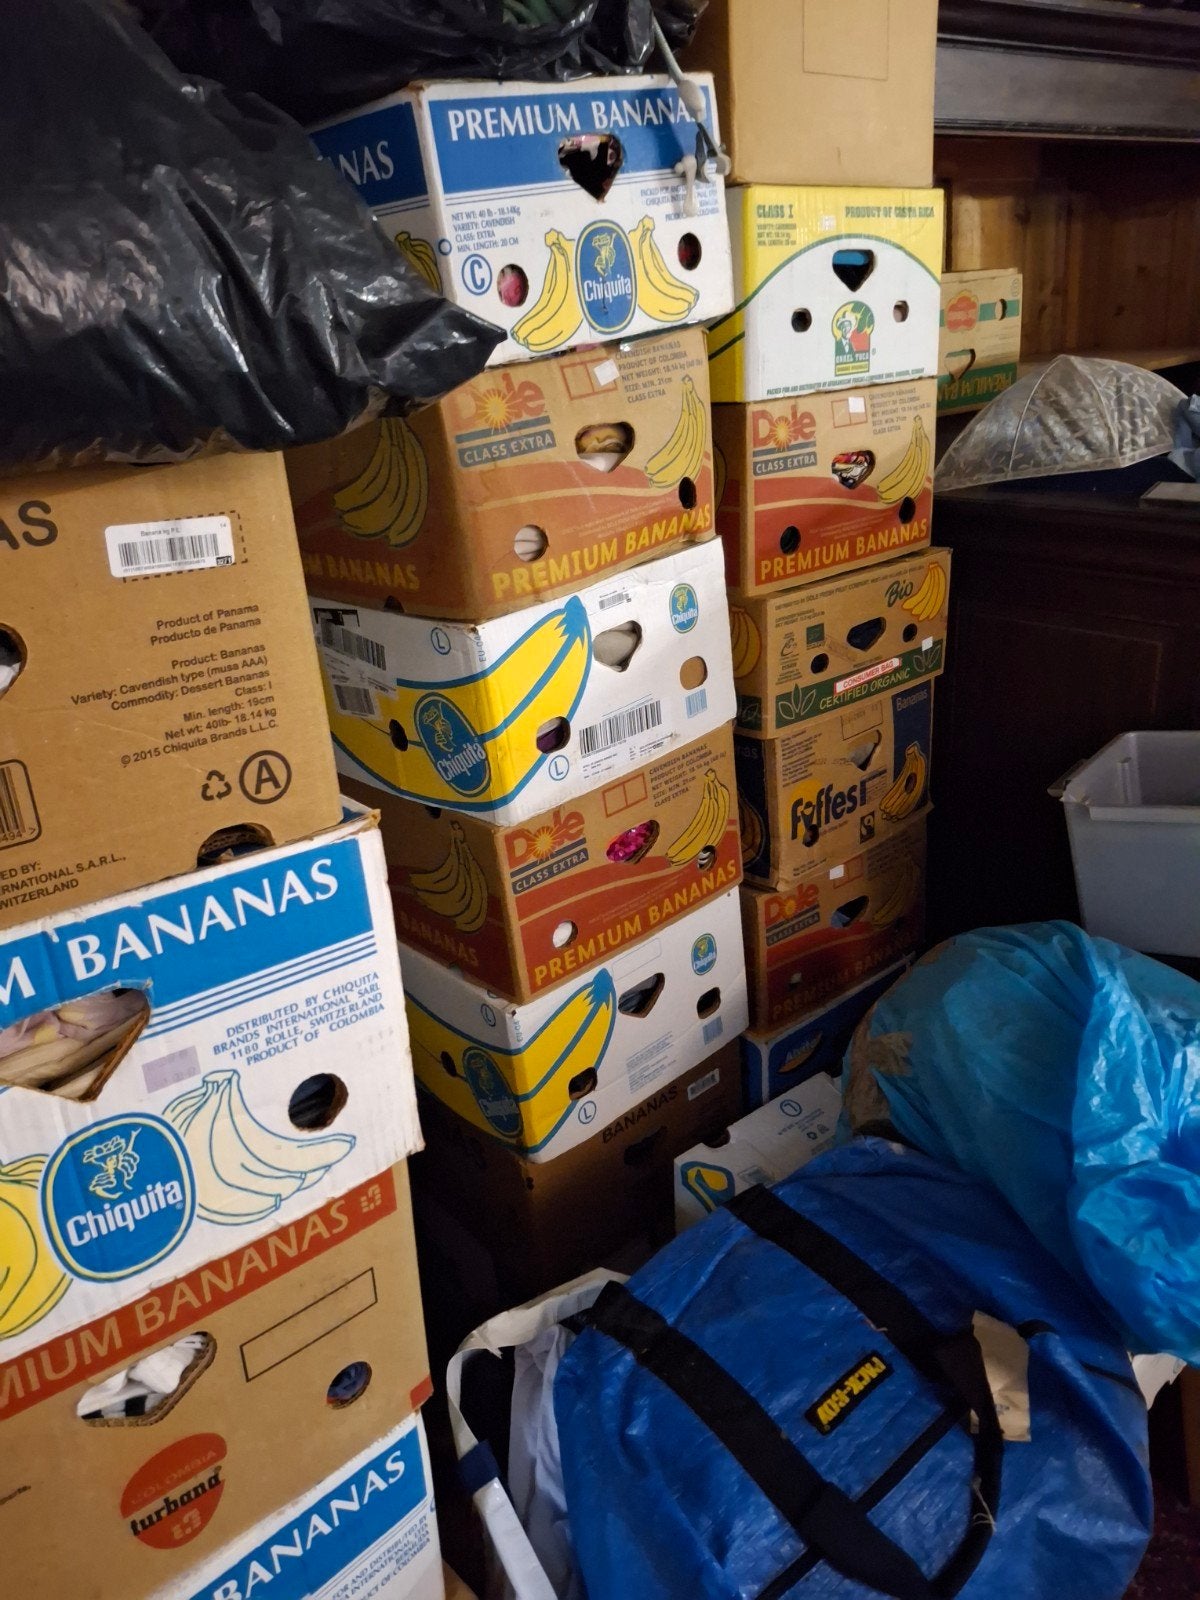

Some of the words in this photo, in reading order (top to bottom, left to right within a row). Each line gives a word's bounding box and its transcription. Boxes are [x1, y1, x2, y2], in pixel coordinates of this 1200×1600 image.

[448, 103, 581, 141] PREMIUM
[592, 96, 698, 130] BANANA
[452, 212, 463, 221] NET
[481, 216, 515, 228] CAVENDISH
[757, 205, 785, 218] CLASS
[788, 205, 794, 218] I
[845, 206, 882, 218] PRODUCT
[883, 206, 892, 218] OF
[894, 206, 917, 218] COSTA
[477, 230, 495, 241] EXTRA
[500, 239, 508, 247] 20
[583, 274, 632, 305] Chiquita
[619, 359, 647, 371] PRODUCT
[622, 373, 634, 381] NET
[446, 373, 548, 429] Dole
[628, 393, 647, 403] CLASS
[648, 389, 666, 399] EXTRA
[752, 404, 816, 449] Dole
[463, 443, 507, 464] CLASS
[511, 434, 554, 455] EXTRA
[756, 459, 784, 474] CLASS
[788, 454, 816, 468] EXTRA
[491, 538, 618, 599] PREMIUM
[625, 504, 711, 554] BANANAS
[761, 540, 849, 580] PREMIUM
[856, 519, 927, 555] BANANAS
[885, 580, 914, 608] Bio
[150, 630, 200, 646] Producto
[203, 625, 217, 635] de
[220, 617, 261, 632] Panama
[157, 614, 201, 630] Product
[203, 611, 213, 621] of
[217, 604, 259, 619] Panama
[671, 609, 698, 626] Chiquita
[171, 654, 217, 669] Product:
[220, 644, 266, 660] Bananas
[71, 689, 117, 705] Variety:
[119, 675, 178, 694] Cavendish
[180, 669, 205, 683] type
[207, 663, 239, 678] (musa
[242, 655, 268, 669] AAA)
[111, 690, 178, 711] Commodity:
[180, 679, 223, 696] Dessert
[225, 669, 270, 686] Bananas
[234, 683, 267, 697] Class:
[820, 684, 868, 710] CERTIFIED
[870, 668, 910, 692] ORGANIC
[843, 668, 880, 689] CONSUMER
[165, 729, 185, 741] Net
[186, 726, 203, 737] wt:
[234, 712, 263, 724] 18.14
[265, 707, 277, 719] kg
[183, 711, 205, 722] Min.
[207, 701, 245, 718] length:
[247, 695, 275, 707] 19cm
[133, 747, 161, 763] 2015
[163, 736, 208, 754] Chiquita
[210, 727, 247, 743] Brands
[437, 740, 486, 781] Chiquita
[253, 759, 282, 794] A
[651, 767, 676, 783] PRODUCT
[655, 796, 671, 808] CLASS
[672, 787, 689, 799] EXTRA
[504, 808, 585, 868] Dole
[21, 861, 41, 874] BY:
[515, 870, 550, 893] CLASS
[553, 850, 588, 876] EXTRA
[67, 858, 339, 981] BANANAS
[764, 883, 819, 928] Dole
[534, 915, 642, 987] PREMIUM
[649, 860, 736, 924] BANANAS
[213, 1031, 260, 1055] BRANDS
[266, 995, 350, 1034] INTERNATIONAL
[358, 982, 380, 997] SARL
[226, 1003, 298, 1038] DISTRIBUTED
[305, 995, 318, 1007] BY
[323, 972, 379, 999] CHIQUITA
[231, 1042, 259, 1060] 1180
[264, 1025, 304, 1045] ROLLE,
[309, 993, 382, 1028] SWITZERLAND
[246, 1040, 299, 1065] PRODUCT
[305, 1030, 320, 1042] OF
[329, 1004, 385, 1032] COLOMBIA
[602, 1085, 678, 1144] BANANAS
[66, 1179, 183, 1249] Chiquita
[135, 1199, 349, 1336] BANANAS
[131, 1472, 221, 1536] turbana
[213, 1451, 406, 1600] BANANAS
[351, 1568, 368, 1584] AND
[370, 1524, 418, 1569] DISTRIBUTED
